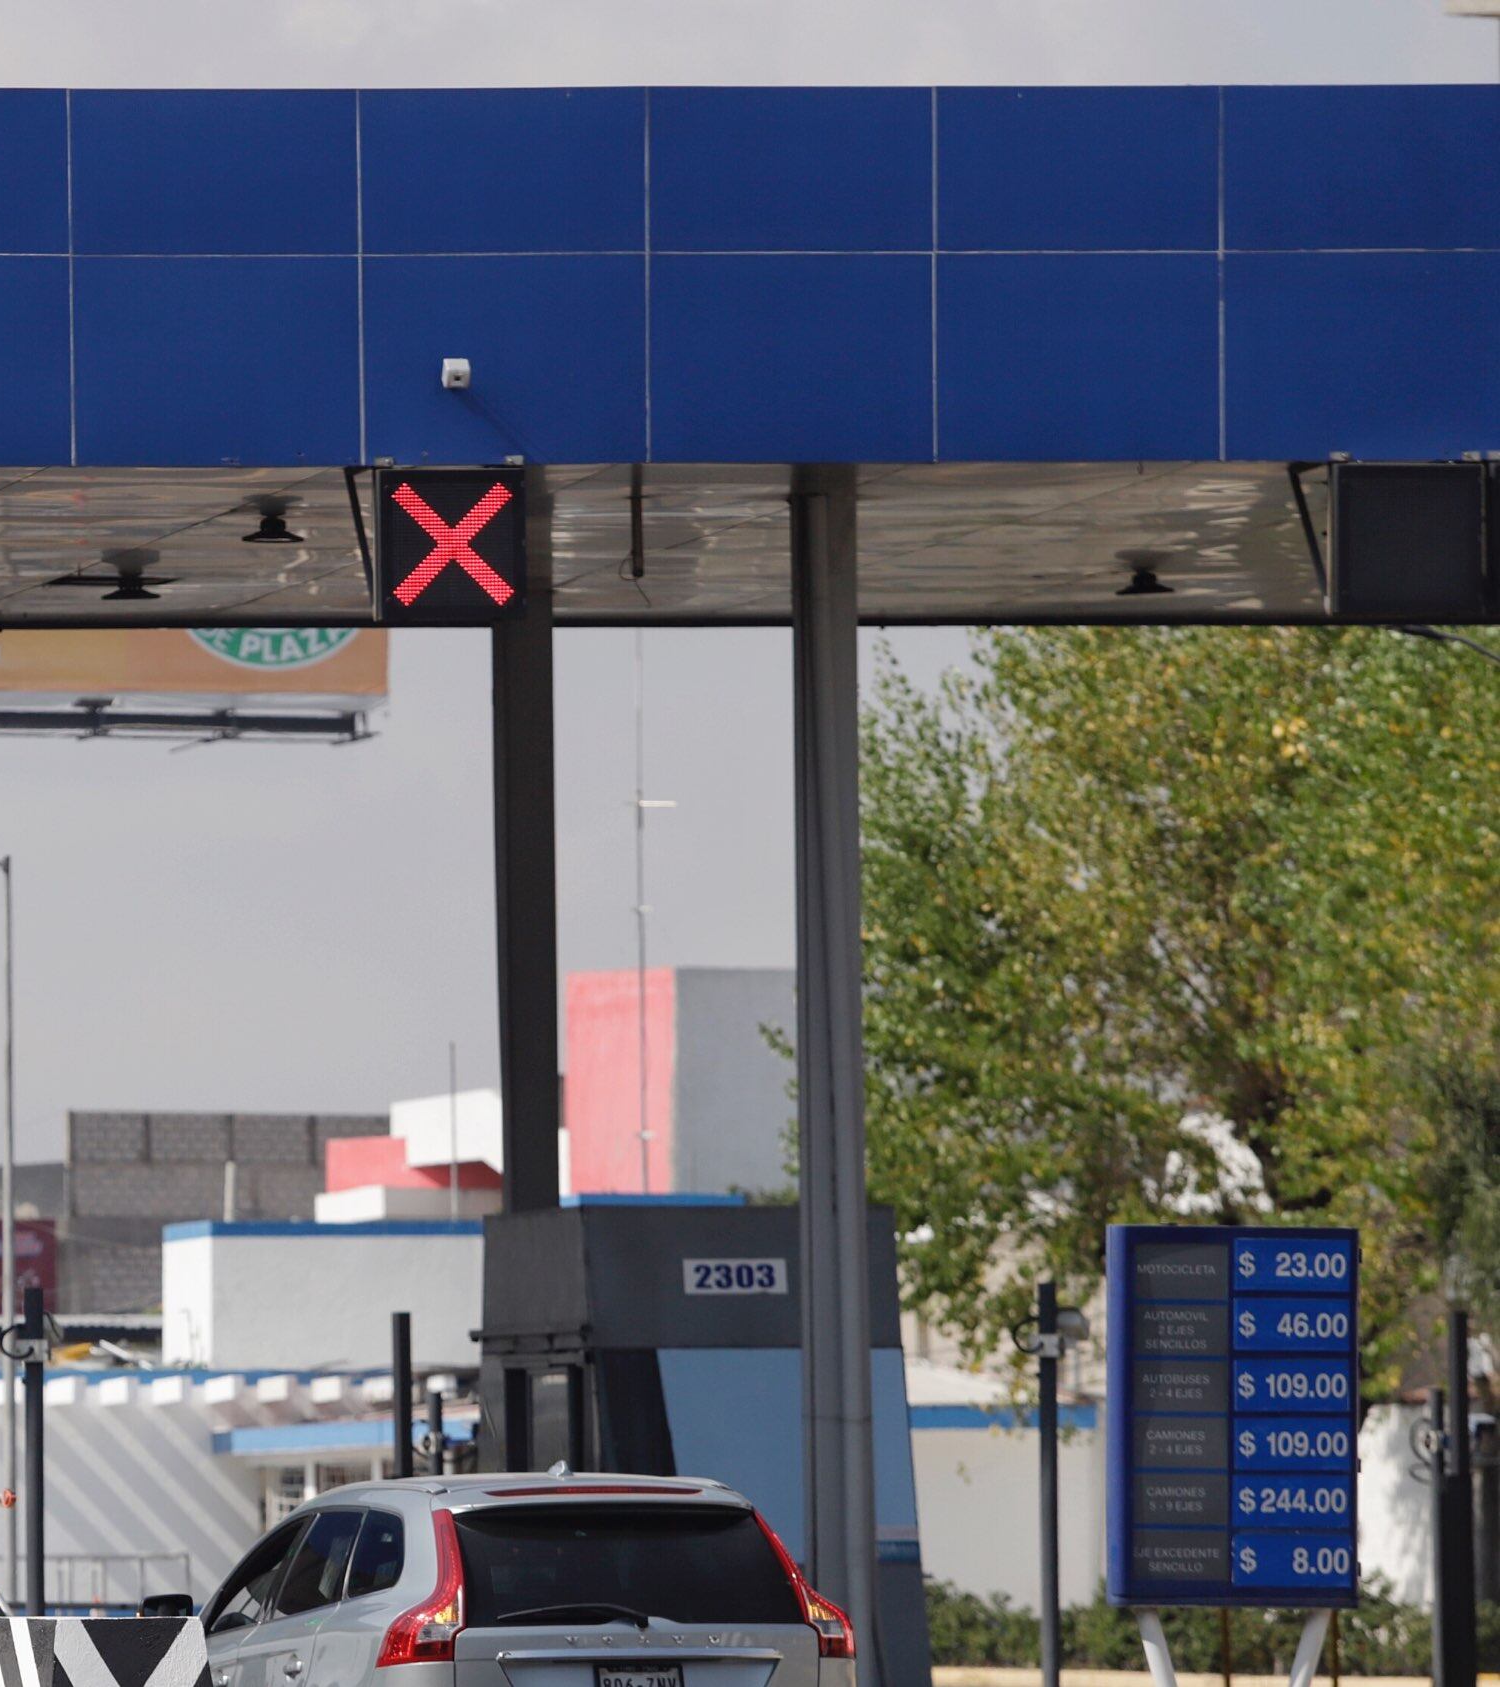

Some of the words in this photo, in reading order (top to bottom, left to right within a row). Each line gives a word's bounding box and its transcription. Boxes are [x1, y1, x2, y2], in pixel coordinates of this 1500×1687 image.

[1136, 1264, 1216, 1275] MOTOCICLETA
[1275, 1252, 1347, 1278] 23.00
[693, 1264, 776, 1289] 2303
[1167, 1325, 1195, 1335] EJES
[1276, 1312, 1348, 1338] 46.00
[1145, 1339, 1207, 1350] SENCILLOS
[1143, 1374, 1211, 1385] AUTOBUSES
[1266, 1372, 1348, 1399] 109.00
[1166, 1388, 1172, 1398] 4
[1175, 1388, 1202, 1398] EJES
[1146, 1430, 1206, 1441] CAMIONES
[1166, 1445, 1172, 1455] 4
[1175, 1445, 1202, 1455] EJES
[1266, 1431, 1348, 1458] 109.00
[1146, 1487, 1206, 1498] CAMIONES
[1176, 1502, 1203, 1512] EJES
[1154, 1548, 1220, 1559] EXCEDENTE
[1292, 1547, 1350, 1574] 8.00
[1149, 1562, 1203, 1573] SENCILLO
